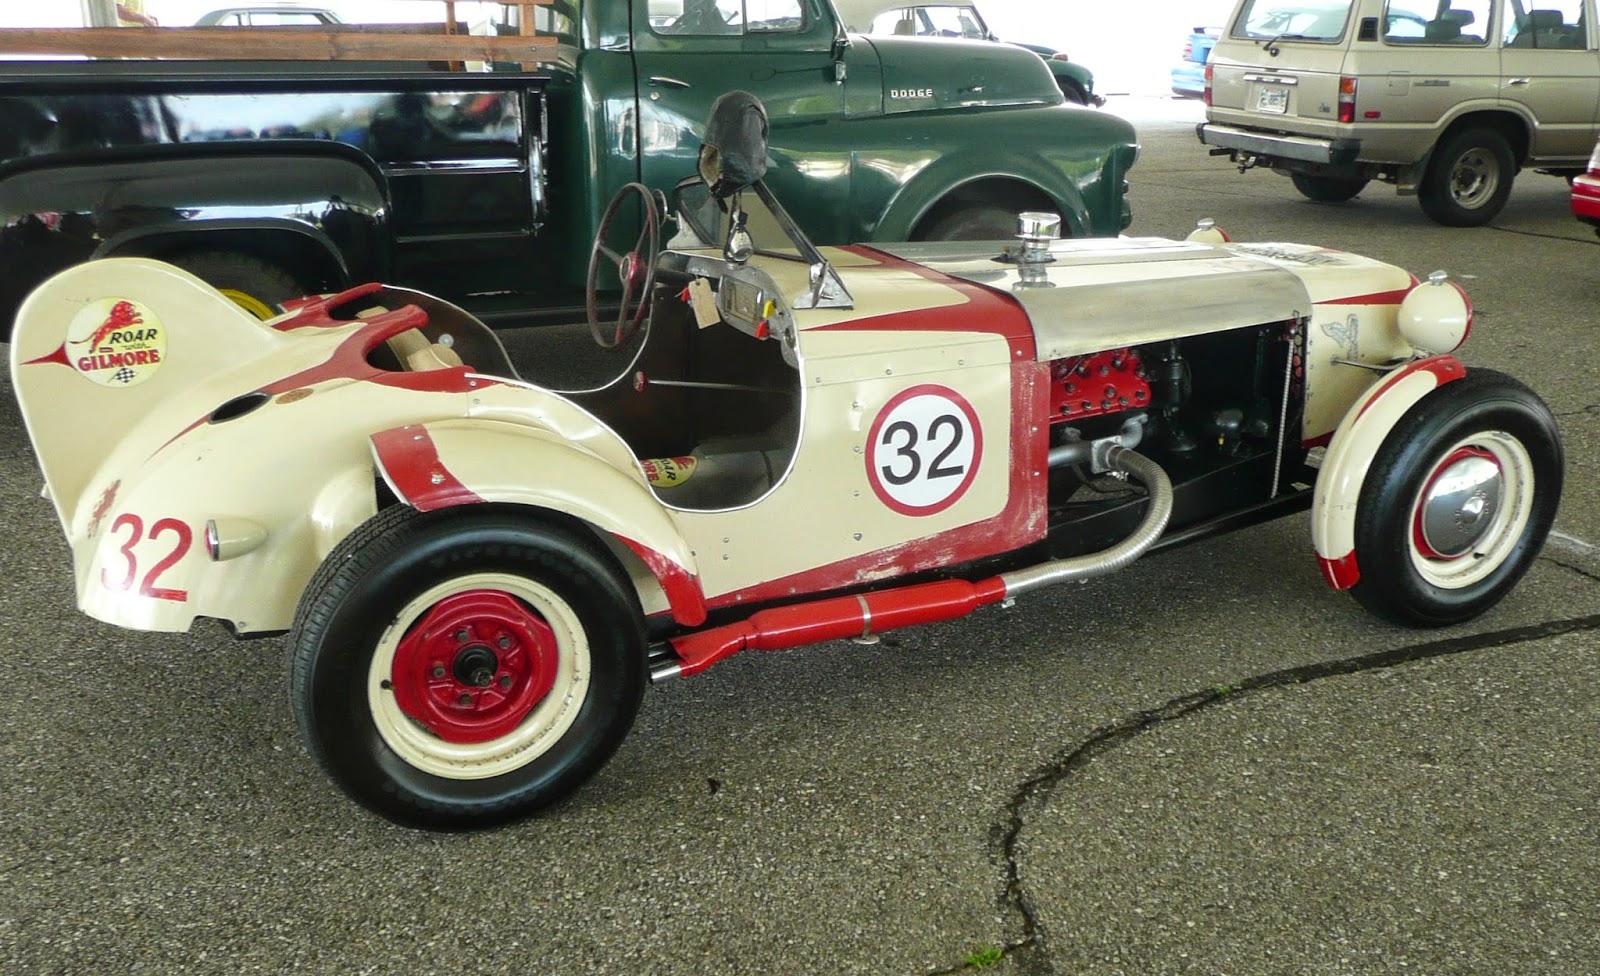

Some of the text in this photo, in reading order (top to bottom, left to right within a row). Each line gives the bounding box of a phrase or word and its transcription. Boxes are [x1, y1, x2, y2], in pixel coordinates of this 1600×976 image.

[890, 88, 933, 98] DODGE
[109, 328, 158, 344] ROAR
[78, 349, 161, 372] GILMORE
[881, 414, 964, 486] 32
[101, 513, 192, 602] 32
